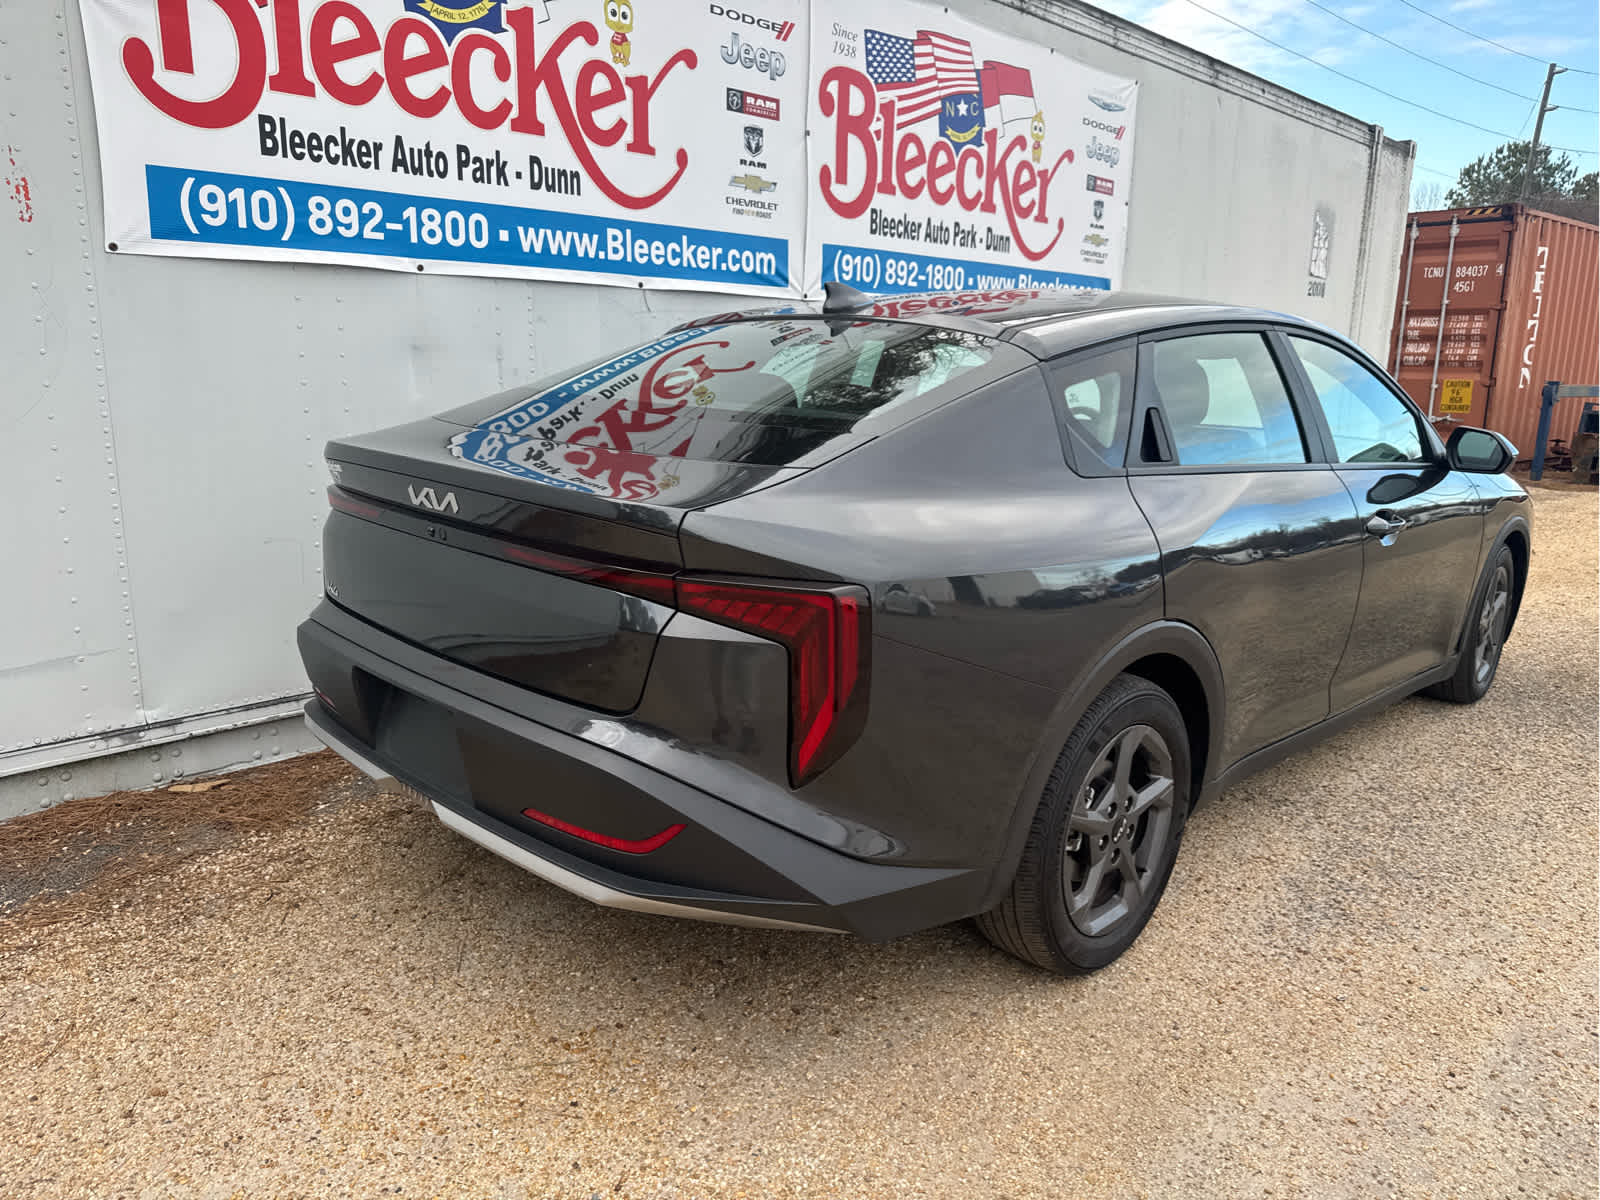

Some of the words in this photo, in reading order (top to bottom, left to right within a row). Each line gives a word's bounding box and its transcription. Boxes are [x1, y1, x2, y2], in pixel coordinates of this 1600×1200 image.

[709, 3, 785, 34] DODGE
[832, 22, 859, 42] Since
[720, 32, 786, 81] Jeep
[832, 41, 857, 58] 1938
[746, 96, 777, 110] RAM
[945, 100, 955, 117] N
[970, 101, 980, 117] C
[258, 114, 383, 170] Bleecker
[392, 135, 449, 180] Auto
[456, 144, 509, 187] Park
[529, 155, 582, 196] Dunn
[739, 158, 767, 169] RAM
[819, 65, 1074, 261] Bleecker
[1085, 135, 1120, 168] Jeep
[725, 196, 779, 211] CHEVROLET
[180, 177, 295, 241] (910)
[307, 196, 489, 249] 892-1800
[517, 224, 777, 276] www.Bleecker.com
[869, 207, 922, 240] Bleecker
[924, 217, 950, 245] Auto
[952, 222, 977, 249] Park
[985, 232, 1011, 254] Dunn
[833, 249, 880, 289] (910)
[885, 258, 965, 291] 892-1800
[1423, 266, 1444, 278] TCNU
[1455, 265, 1489, 278] 884037
[1496, 263, 1504, 276] 4
[407, 483, 459, 514] KIA
